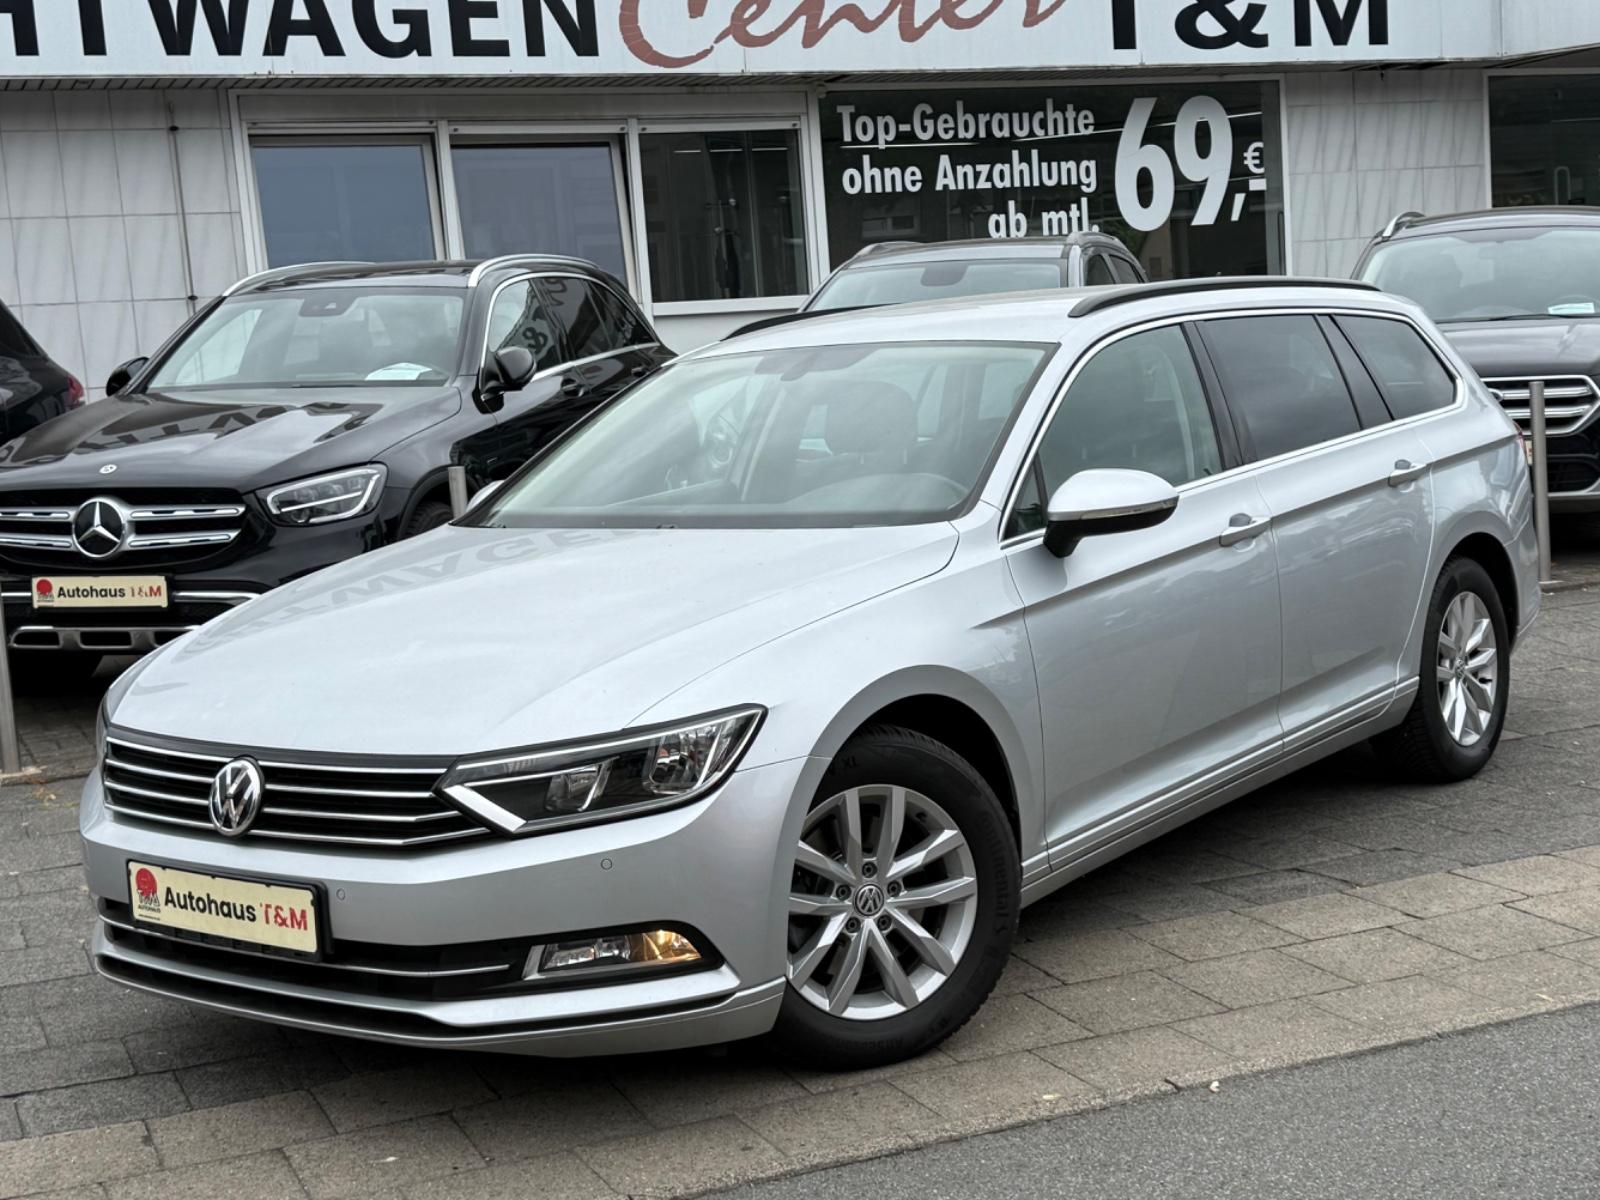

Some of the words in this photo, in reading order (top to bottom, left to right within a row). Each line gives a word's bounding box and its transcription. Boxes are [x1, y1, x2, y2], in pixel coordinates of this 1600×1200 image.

[836, 98, 1095, 149] Top-Gebrauchte
[843, 154, 922, 195] ohne
[935, 149, 1097, 193] Anzahlung
[988, 200, 1028, 238] ab
[1042, 197, 1100, 236] mtl.
[57, 586, 126, 598] Autohaus
[165, 887, 257, 923] Autohaus
[259, 902, 308, 931] T&M
